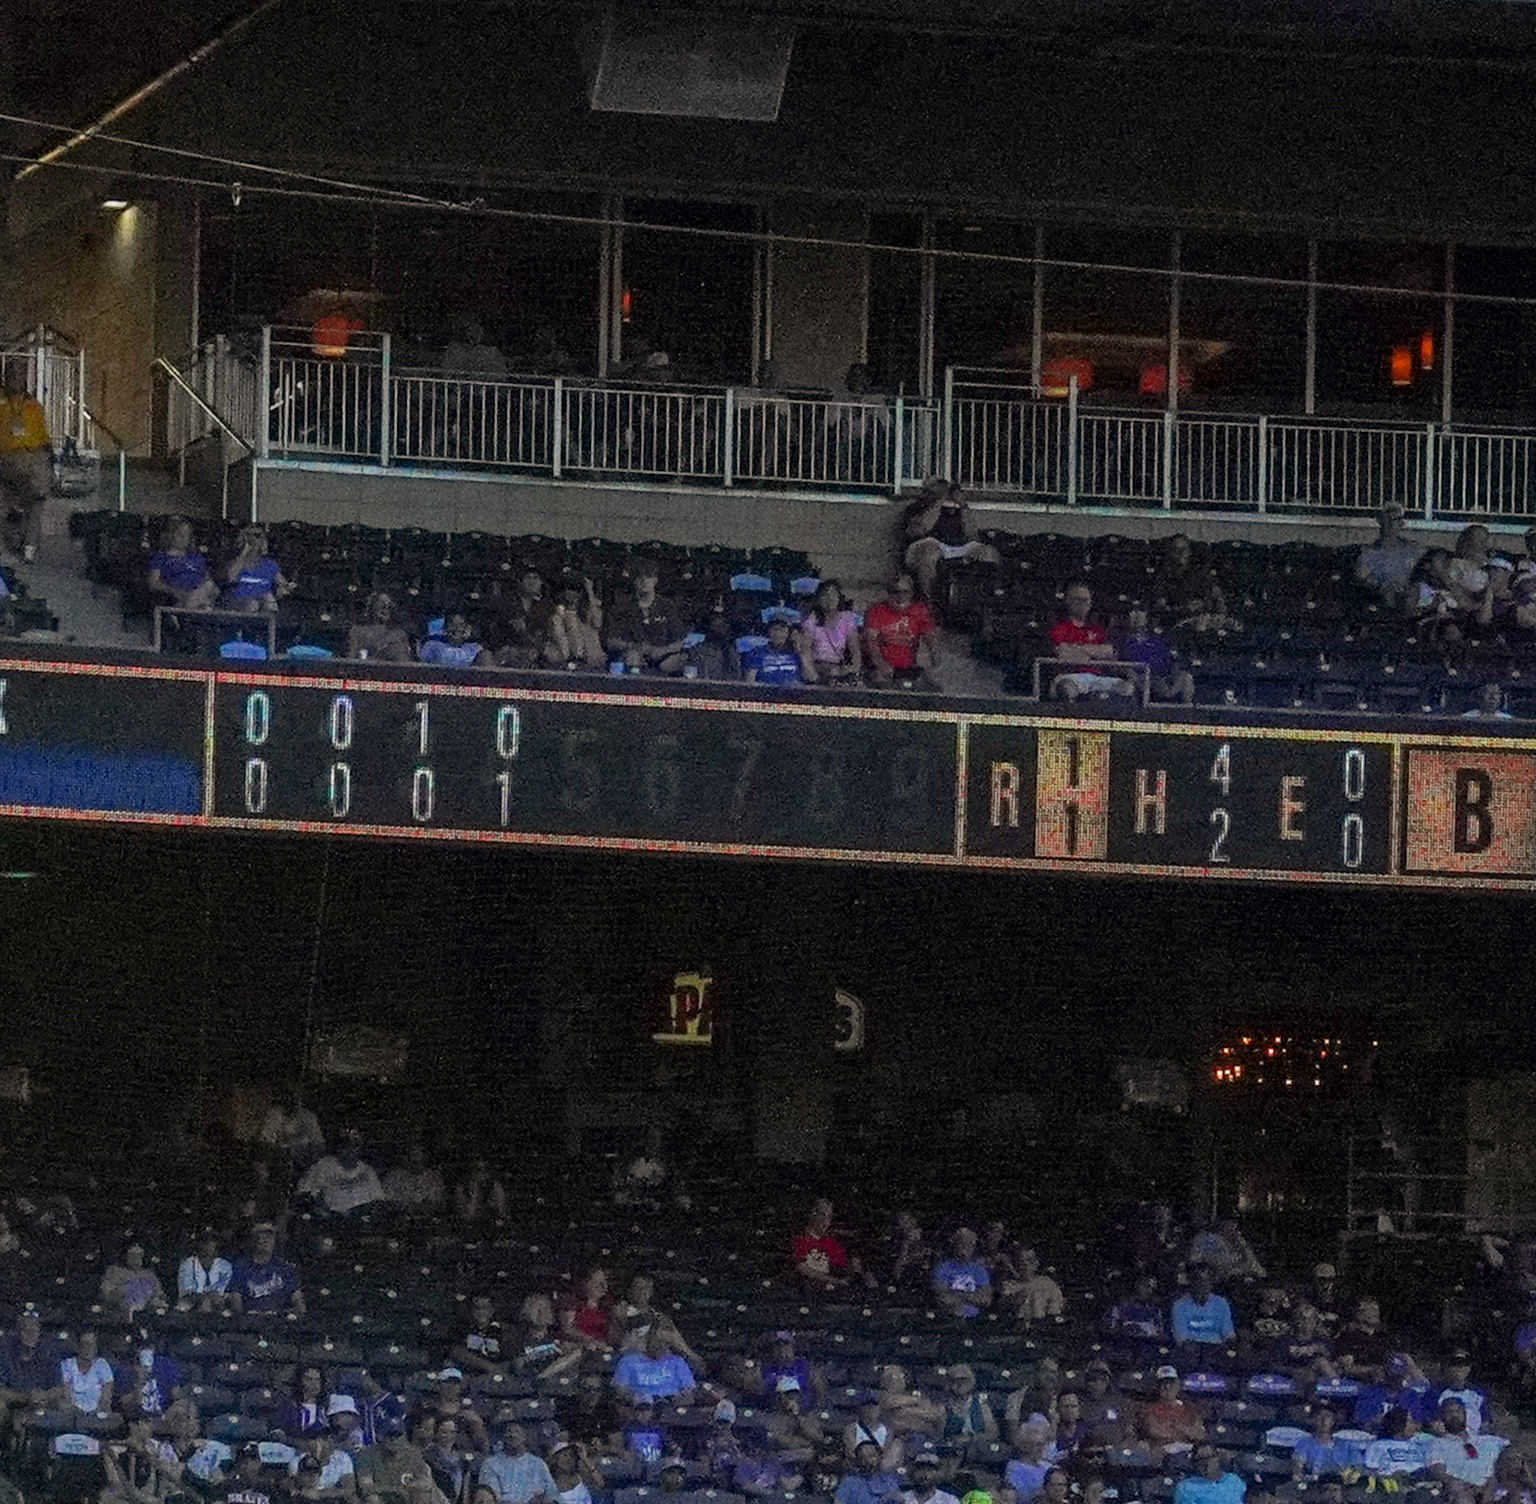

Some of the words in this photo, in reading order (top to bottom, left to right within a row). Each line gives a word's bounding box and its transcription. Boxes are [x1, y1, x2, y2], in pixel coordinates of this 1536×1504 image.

[245, 689, 269, 745] 0
[330, 694, 354, 750] 0
[414, 700, 430, 755] 1
[496, 703, 522, 758] 0
[244, 757, 269, 813] 0
[330, 761, 351, 818] 0
[411, 765, 435, 822] 0
[496, 769, 512, 826] 1
[990, 760, 1020, 827] R
[1134, 768, 1167, 835] H
[1211, 743, 1230, 797] 4
[1344, 748, 1366, 800] 0
[1209, 807, 1230, 863] 2
[1279, 775, 1305, 841] E
[1342, 812, 1364, 868] 0
[1453, 766, 1494, 854] B
